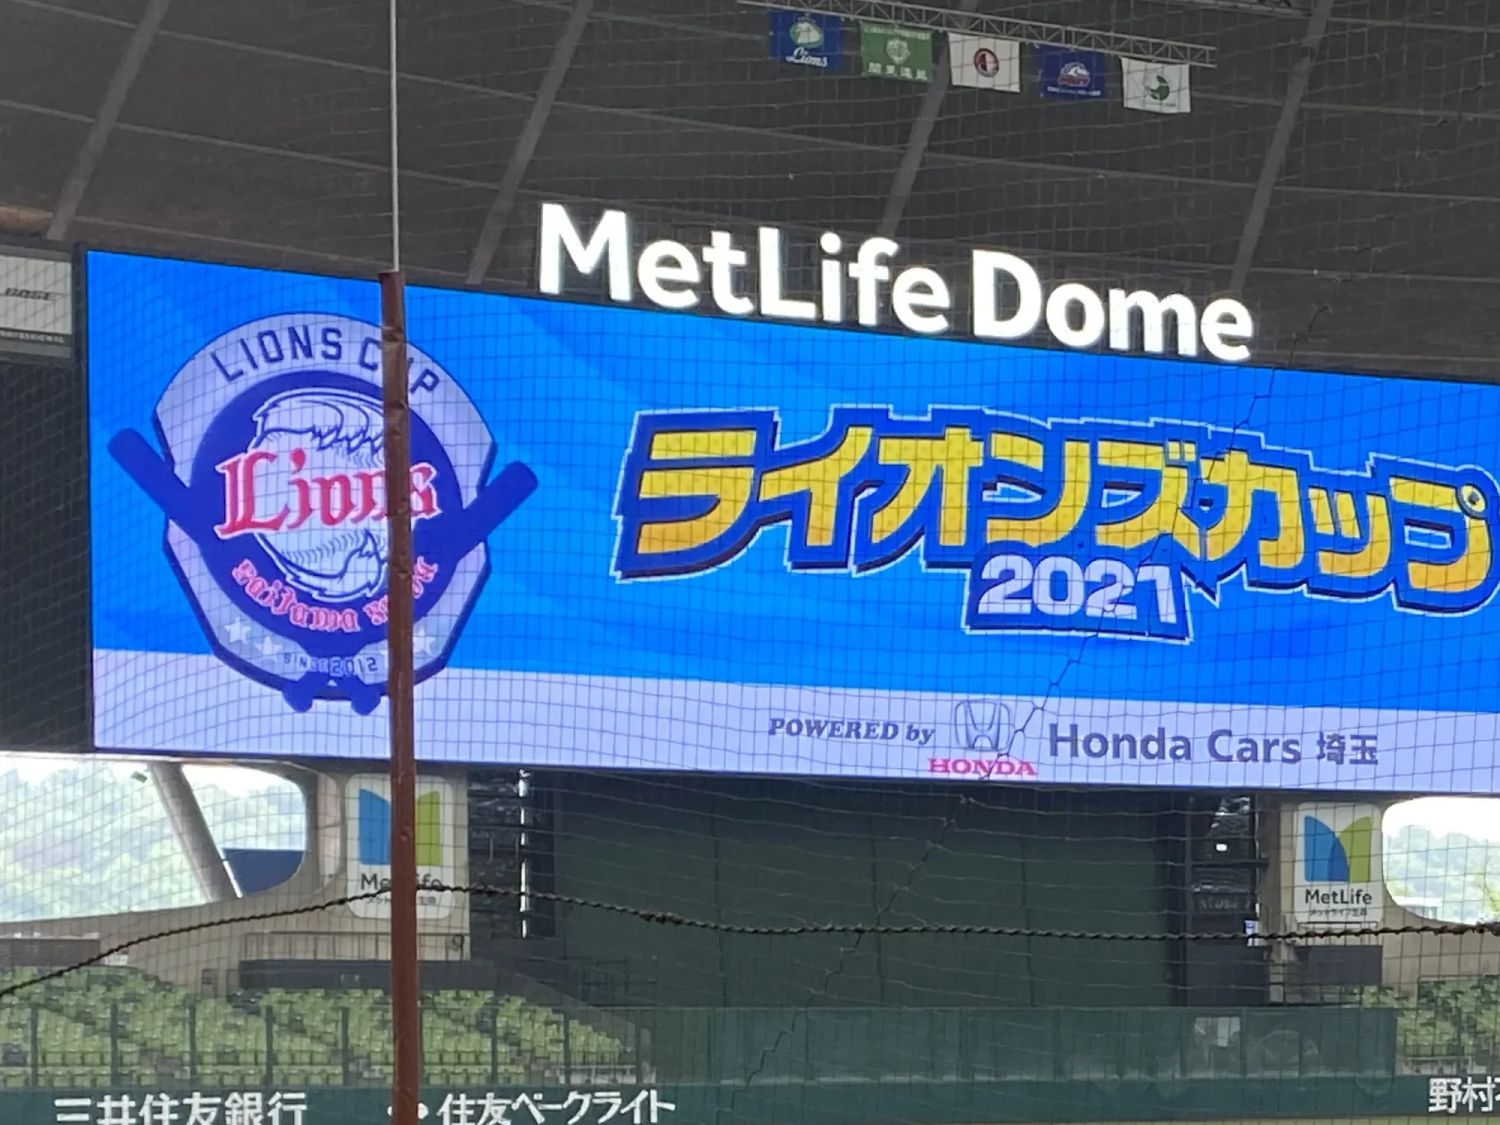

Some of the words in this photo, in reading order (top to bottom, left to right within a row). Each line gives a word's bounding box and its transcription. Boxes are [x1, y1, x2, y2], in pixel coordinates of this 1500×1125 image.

[539, 203, 951, 333] MetLife
[972, 250, 1254, 361] Dome
[211, 325, 343, 382] LIONS
[359, 337, 440, 394] CP
[632, 420, 1495, 597] ライオンズカップ
[979, 554, 1179, 625] 2021
[768, 717, 899, 741] POWERED
[905, 722, 935, 745] by
[1049, 723, 1192, 761] Honda
[1207, 730, 1301, 765] Cars
[1316, 732, 1379, 766] 埼玉
[928, 757, 1037, 777] HONDA
[1305, 889, 1373, 905] MetLife
